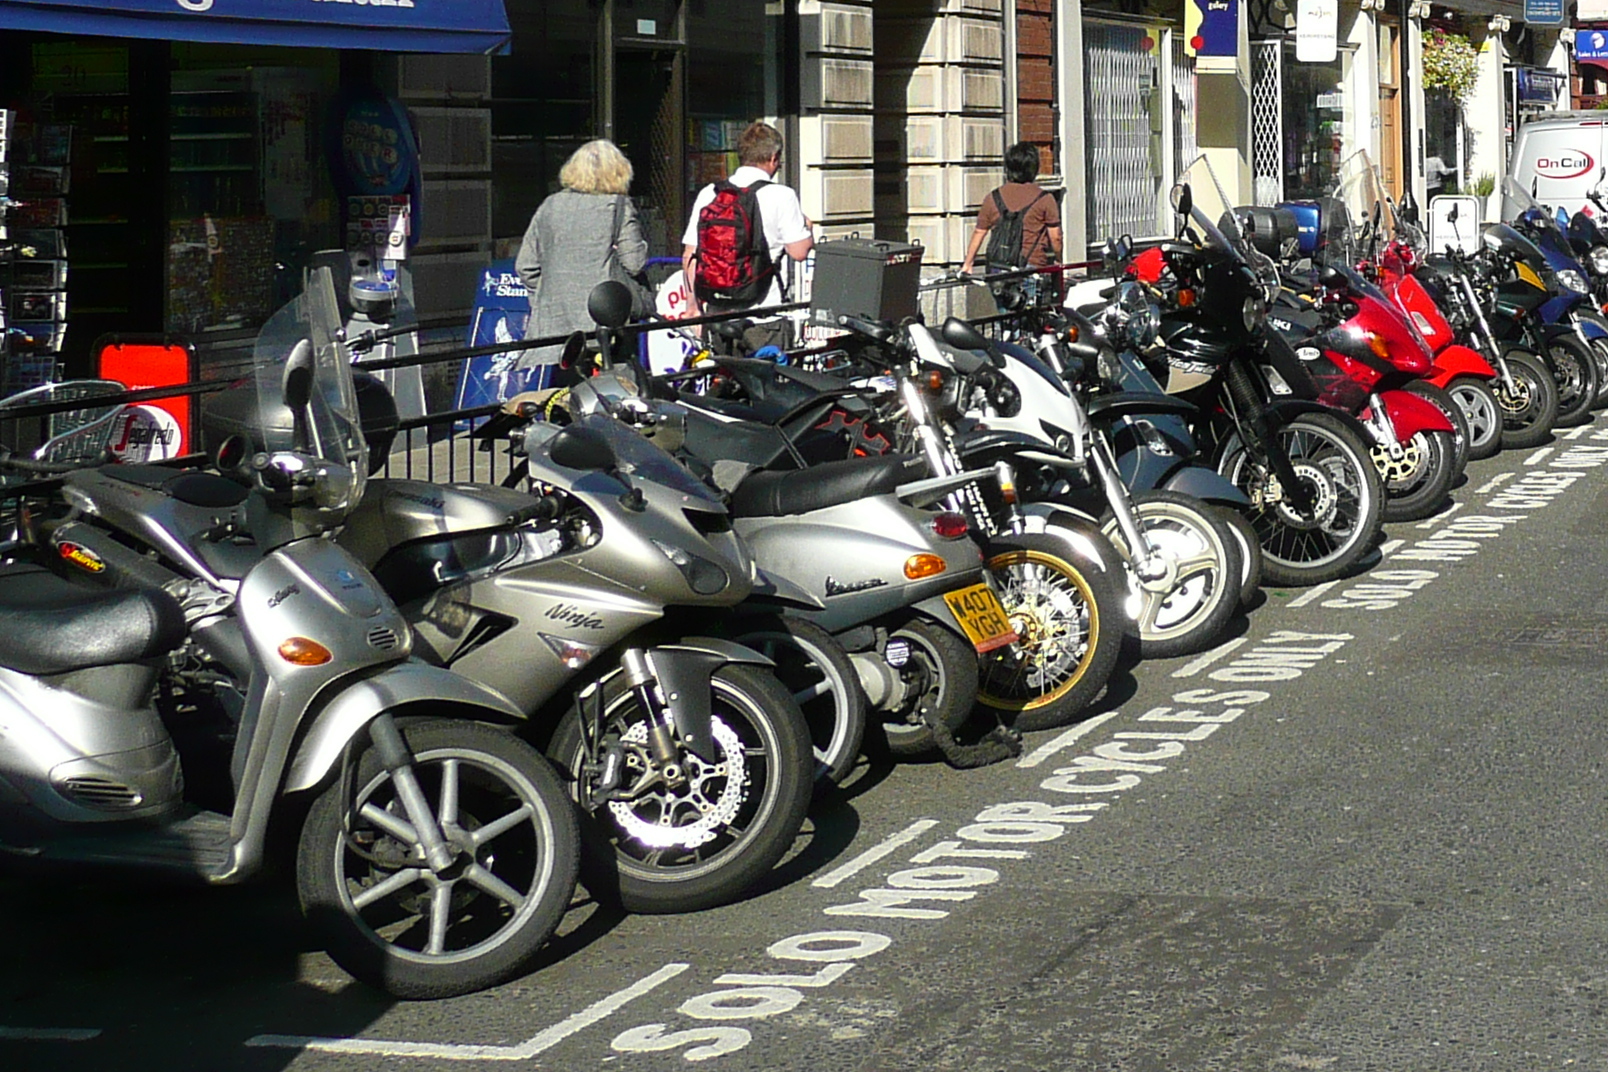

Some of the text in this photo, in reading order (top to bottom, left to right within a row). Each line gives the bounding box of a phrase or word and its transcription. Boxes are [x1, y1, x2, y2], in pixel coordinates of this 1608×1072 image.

[1207, 1, 1229, 11] gallery
[1321, 569, 1440, 610] SOLO
[1389, 515, 1529, 561] MOTOR
[1486, 470, 1587, 509] CYCLES
[544, 603, 605, 630] Ninja
[948, 587, 996, 620] W407
[967, 615, 1008, 641] YGH
[611, 630, 1354, 1061] SOLO MOTOR CYCLES ONLY
